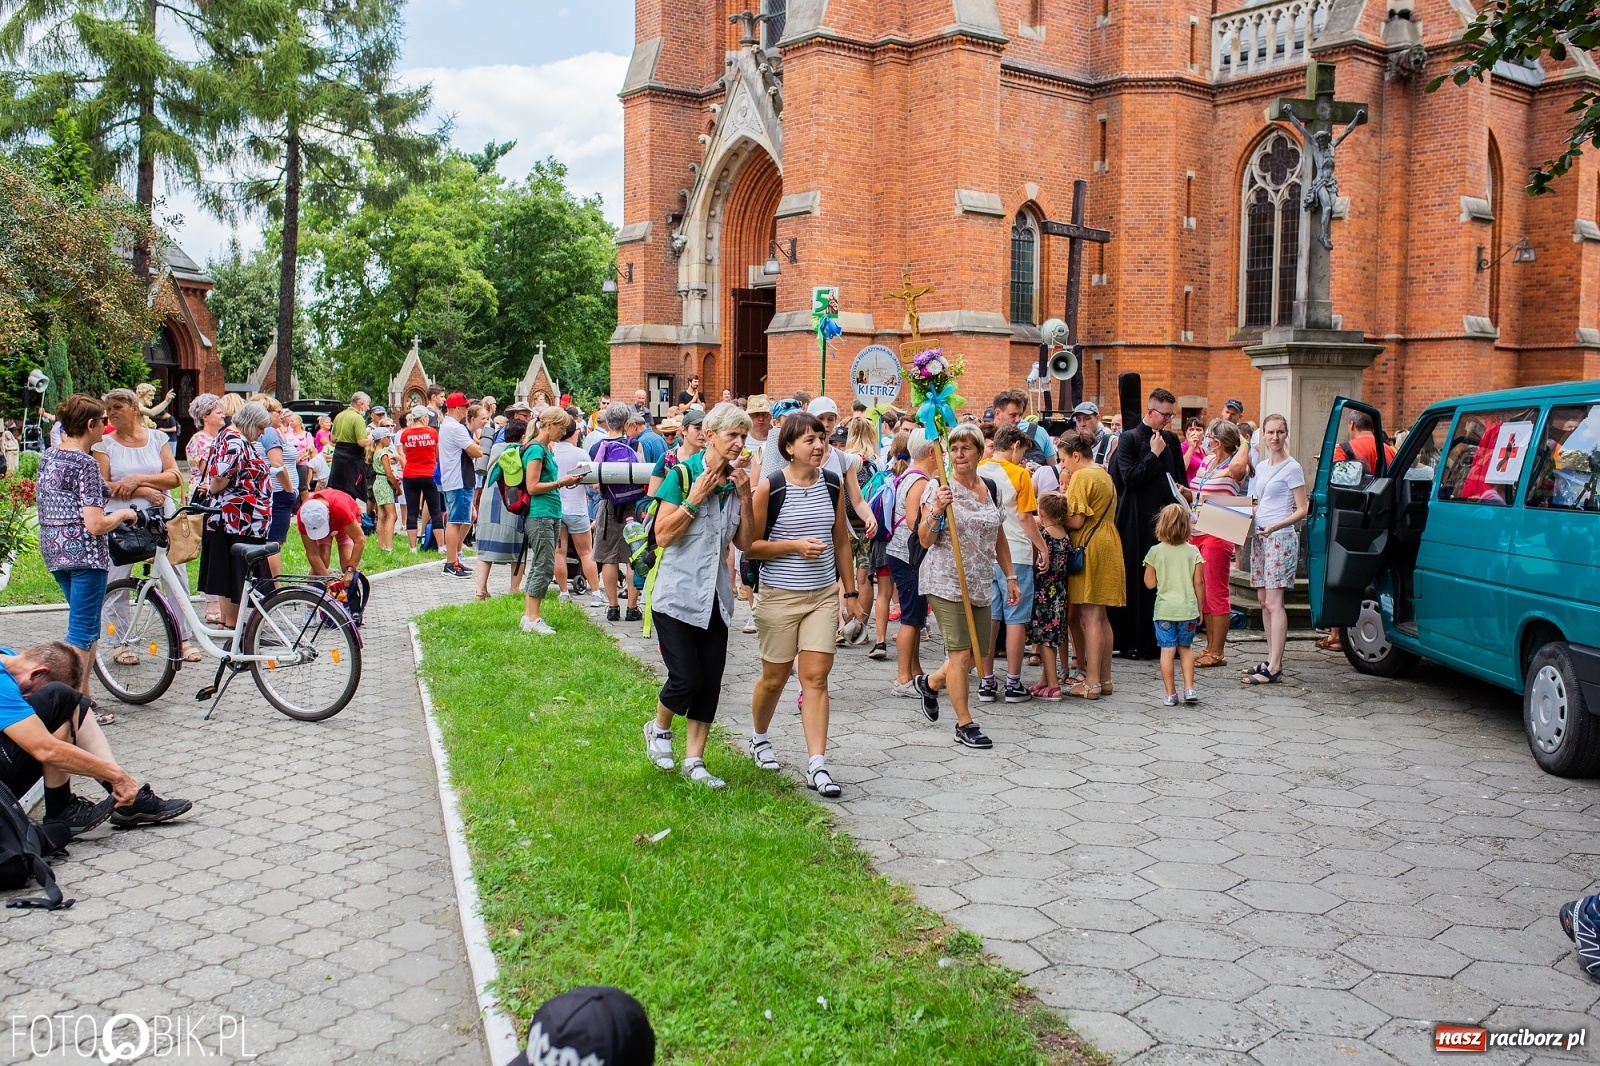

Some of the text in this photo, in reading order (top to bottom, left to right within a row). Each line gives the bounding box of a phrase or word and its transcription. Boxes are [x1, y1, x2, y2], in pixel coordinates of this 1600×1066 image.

[815, 289, 830, 312] 5
[858, 384, 895, 396] KIETRZ
[407, 433, 431, 441] PIKNIK
